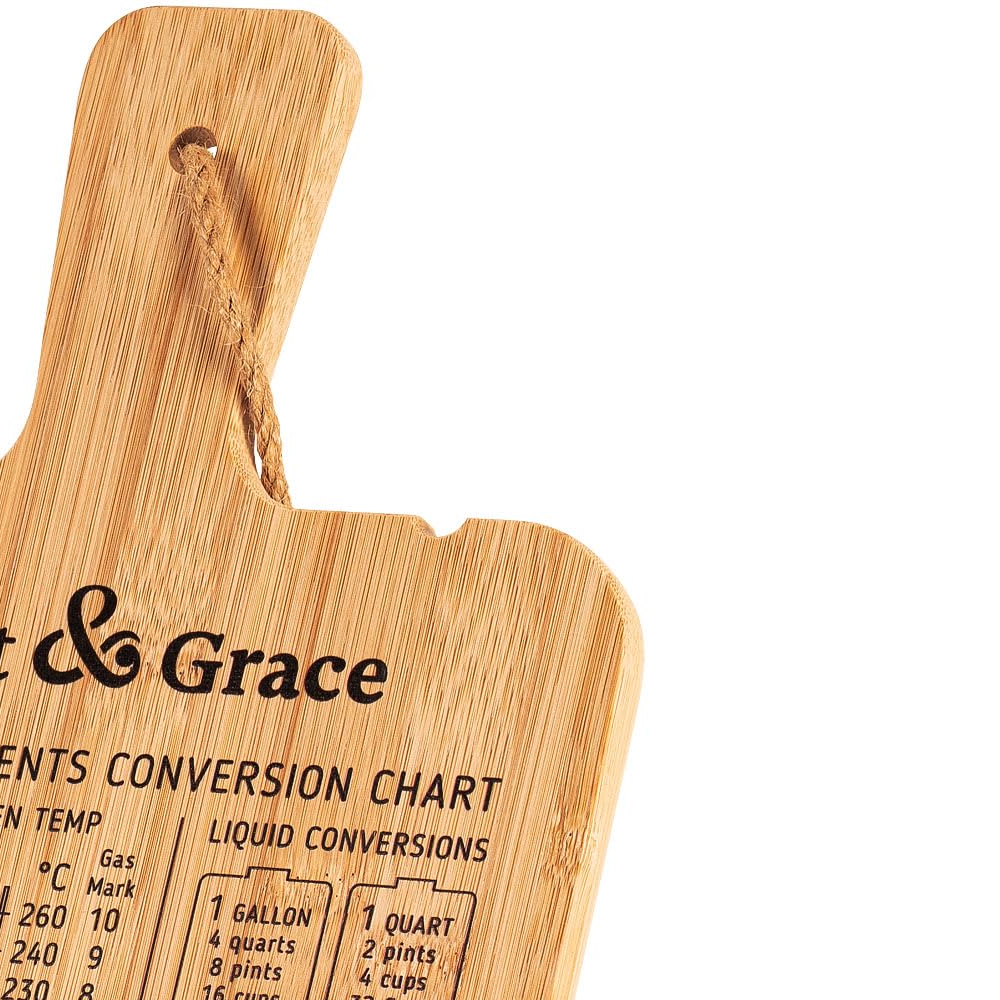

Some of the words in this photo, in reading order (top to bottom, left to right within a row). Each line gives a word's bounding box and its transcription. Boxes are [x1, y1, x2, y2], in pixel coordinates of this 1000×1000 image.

[31, 583, 141, 689] &
[160, 630, 388, 705] Grace
[106, 751, 354, 802] CONVERSION
[370, 768, 503, 813] CHART
[36, 806, 103, 834] TEMP
[208, 818, 295, 851] LIQUID
[305, 825, 490, 863] CONVERSIONS
[99, 848, 135, 870] Gas
[86, 876, 136, 899] Mark
[18, 902, 68, 930] 260
[91, 907, 121, 933] 10
[232, 902, 313, 928] GALLON
[384, 912, 455, 937] QUART
[9, 939, 59, 967] 240
[228, 935, 296, 955] quarts
[382, 941, 436, 965] pints
[229, 959, 282, 983] pints
[380, 973, 428, 995] cups
